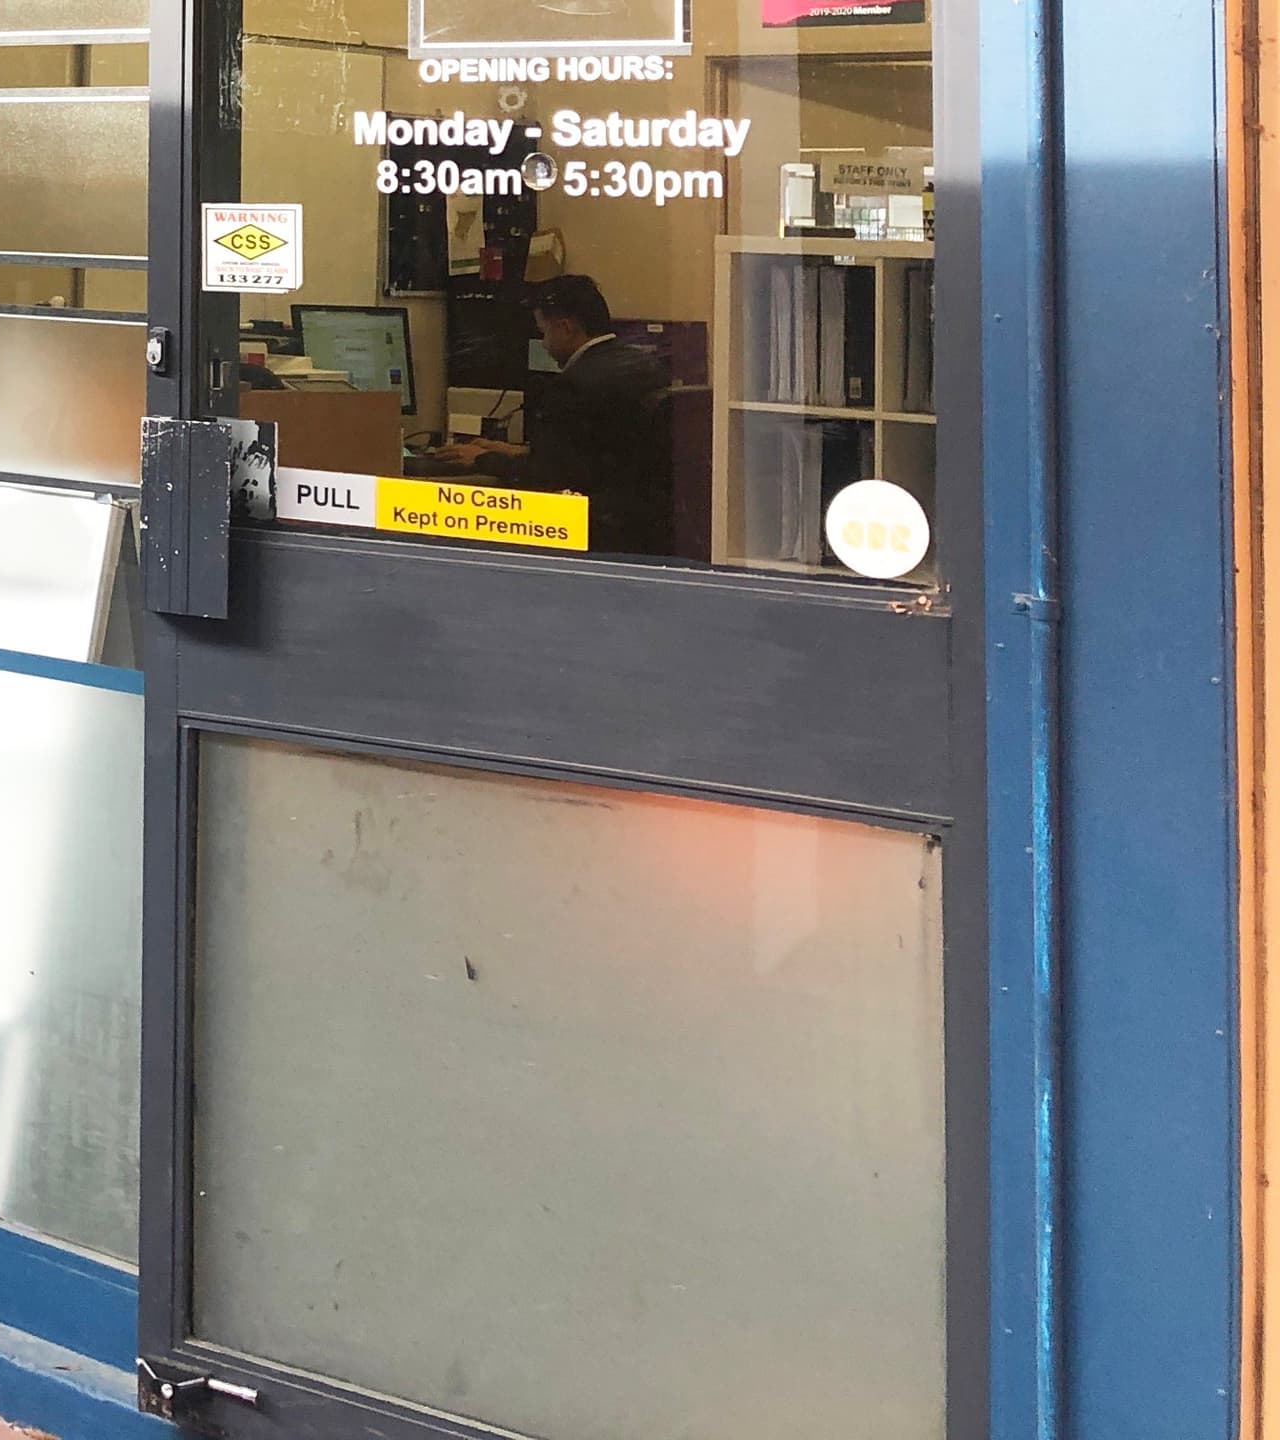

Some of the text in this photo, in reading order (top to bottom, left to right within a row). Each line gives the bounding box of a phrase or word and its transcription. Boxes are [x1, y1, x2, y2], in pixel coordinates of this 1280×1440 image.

[808, 4, 892, 17] 2019-2020 Member
[418, 55, 674, 84] OPENING HOURS:
[353, 111, 514, 155] Monday
[551, 109, 751, 156] Saturday
[376, 159, 523, 195] 8:30am
[563, 160, 724, 206] 5:30pm
[838, 163, 908, 178] STAFF ONLY
[214, 211, 288, 224] WARNING
[231, 233, 271, 250] CSS
[218, 273, 284, 285] 133 277
[296, 483, 360, 510] PULL
[437, 487, 522, 511] No Cash
[393, 507, 569, 540] Kept on Premises
